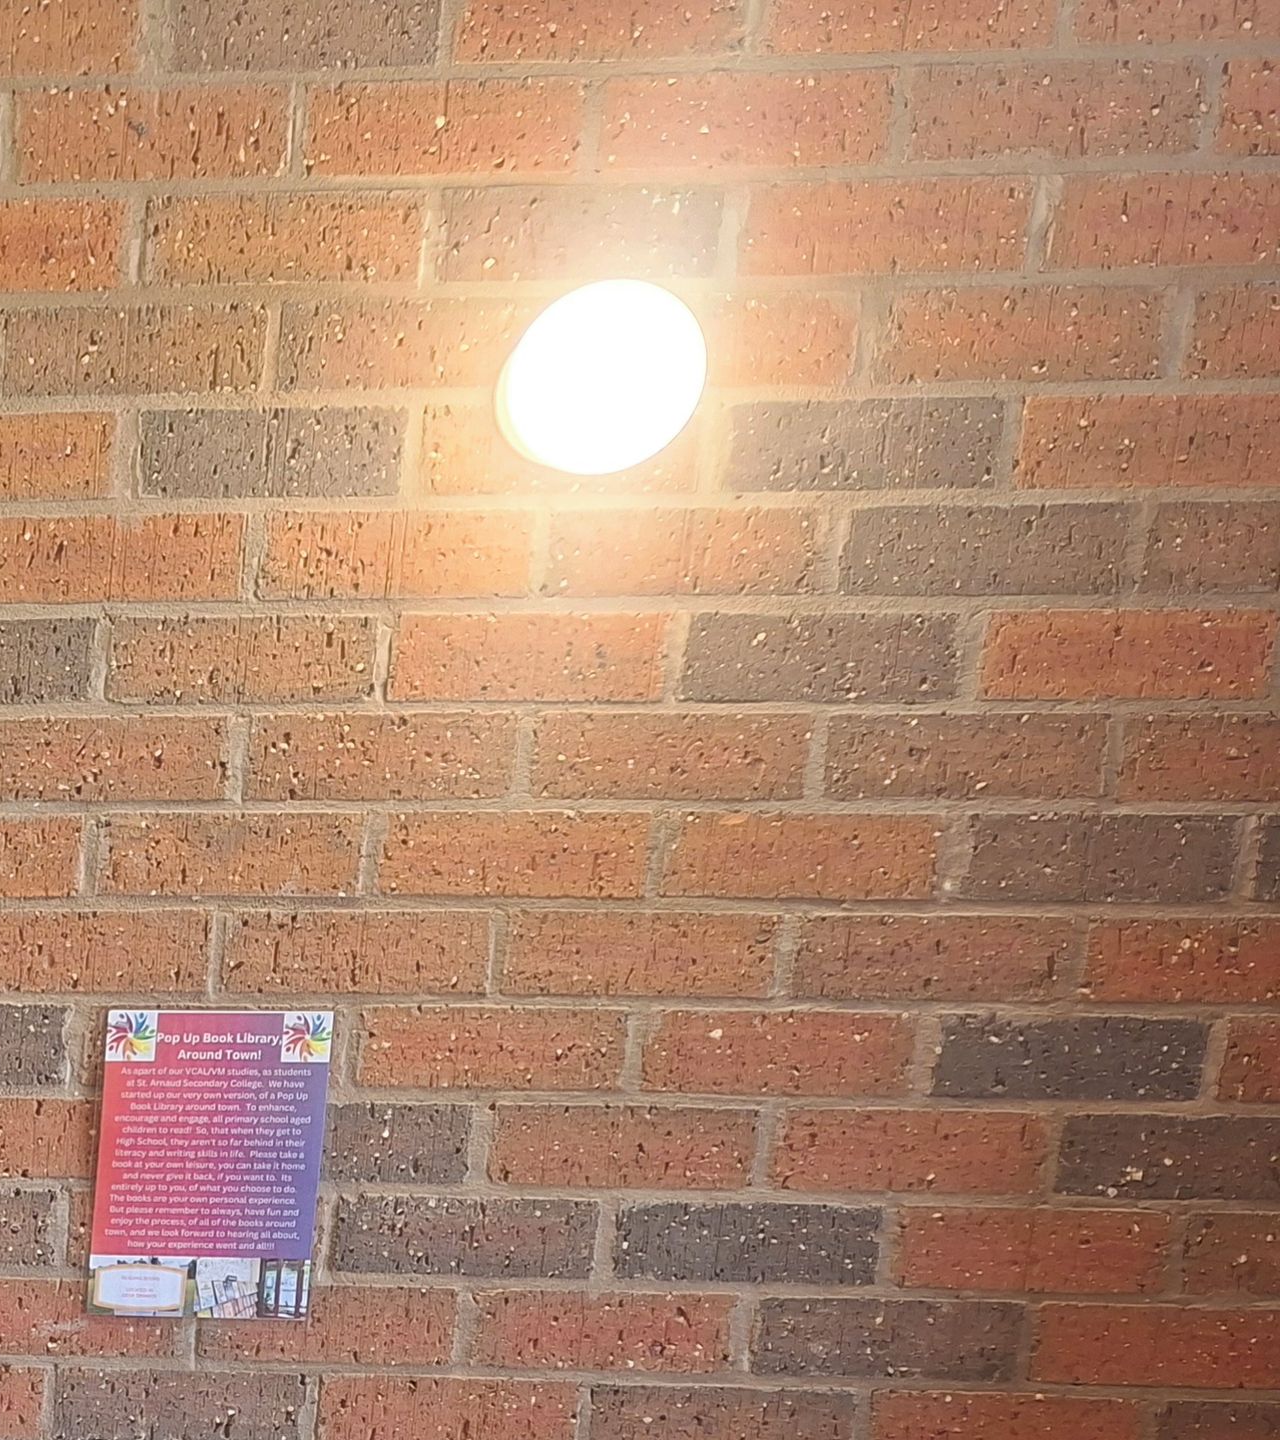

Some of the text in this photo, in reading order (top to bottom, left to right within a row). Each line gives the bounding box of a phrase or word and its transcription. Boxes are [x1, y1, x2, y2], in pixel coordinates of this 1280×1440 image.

[156, 1032, 282, 1046] Pop Up Book Library,
[177, 1049, 261, 1060] Around Town!
[133, 1068, 155, 1077] apart
[226, 1068, 260, 1076] studies,
[182, 1079, 228, 1089] Secondary
[153, 1092, 163, 1100] up
[182, 1093, 201, 1101] very
[223, 1092, 257, 1100] version,
[277, 1092, 292, 1102] Pop
[295, 1092, 308, 1102] Up
[153, 1102, 183, 1112] Library
[258, 1104, 297, 1112] enhance,
[114, 1115, 158, 1123] encourage
[224, 1115, 257, 1125] primary
[289, 1116, 310, 1125] aged
[196, 1126, 208, 1134] So,
[255, 1127, 274, 1136] they
[276, 1128, 290, 1137] get
[115, 1137, 135, 1146] High
[137, 1137, 168, 1145] School,
[170, 1137, 188, 1147] they
[114, 1148, 146, 1158] literacy
[166, 1149, 195, 1159] writing
[111, 1183, 143, 1192] entirely
[145, 1185, 155, 1193] up
[169, 1185, 186, 1193] you,
[222, 1186, 238, 1194] you
[209, 1196, 246, 1205] personal
[248, 1196, 296, 1206] experience.
[125, 1206, 153, 1215] please
[154, 1206, 198, 1214] remember
[211, 1207, 242, 1217] always,
[265, 1219, 295, 1227] around
[146, 1242, 165, 1250] your
[167, 1241, 213, 1251] experience
